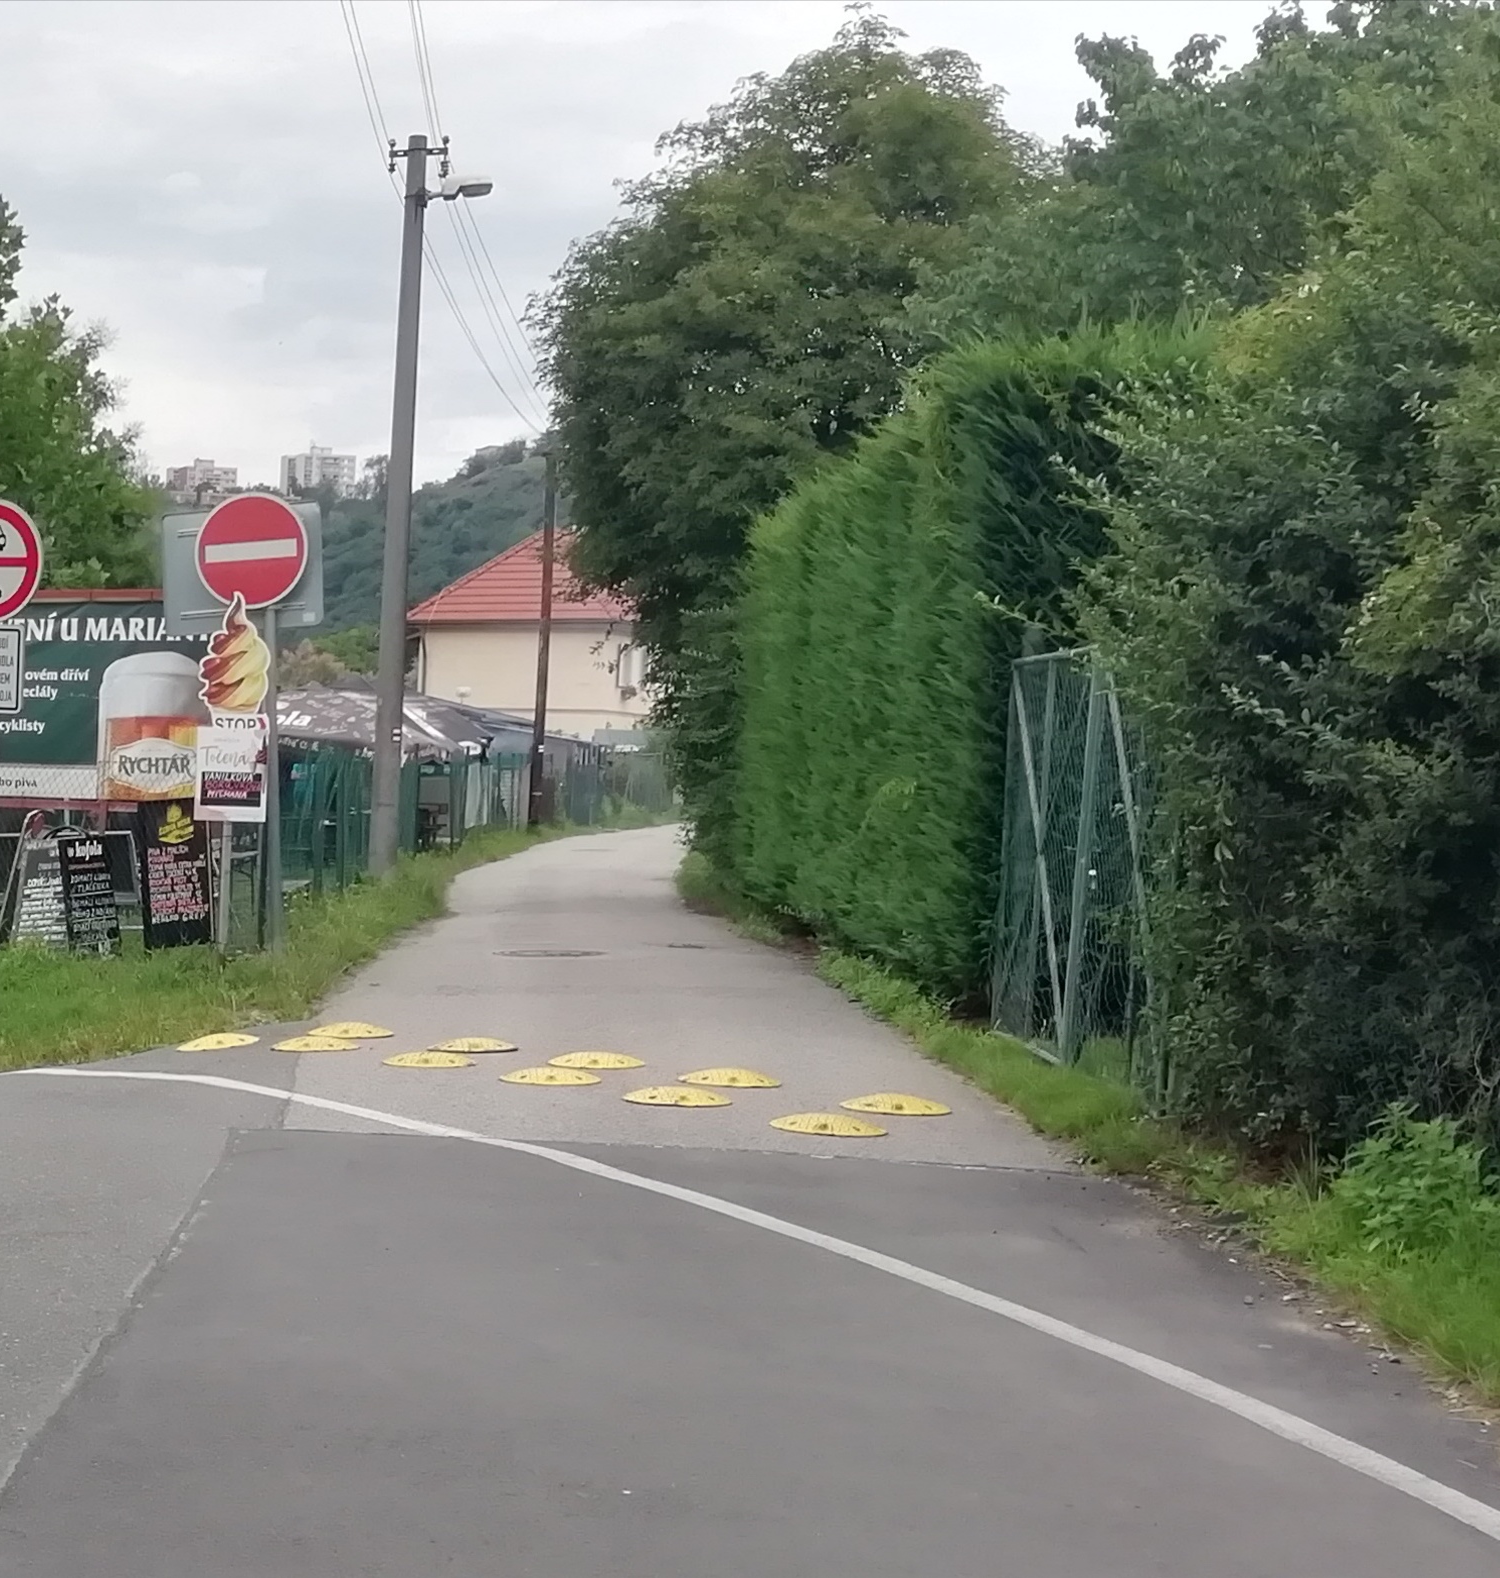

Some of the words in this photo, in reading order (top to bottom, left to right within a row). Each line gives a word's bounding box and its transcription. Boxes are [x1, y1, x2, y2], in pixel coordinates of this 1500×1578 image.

[60, 617, 78, 641] U
[84, 617, 208, 642] MARIA
[60, 668, 90, 681] dříví
[215, 717, 257, 729] STOP
[118, 753, 194, 777] RYCHTÁŘ
[14, 777, 38, 790] piva
[75, 839, 103, 861] kofola
